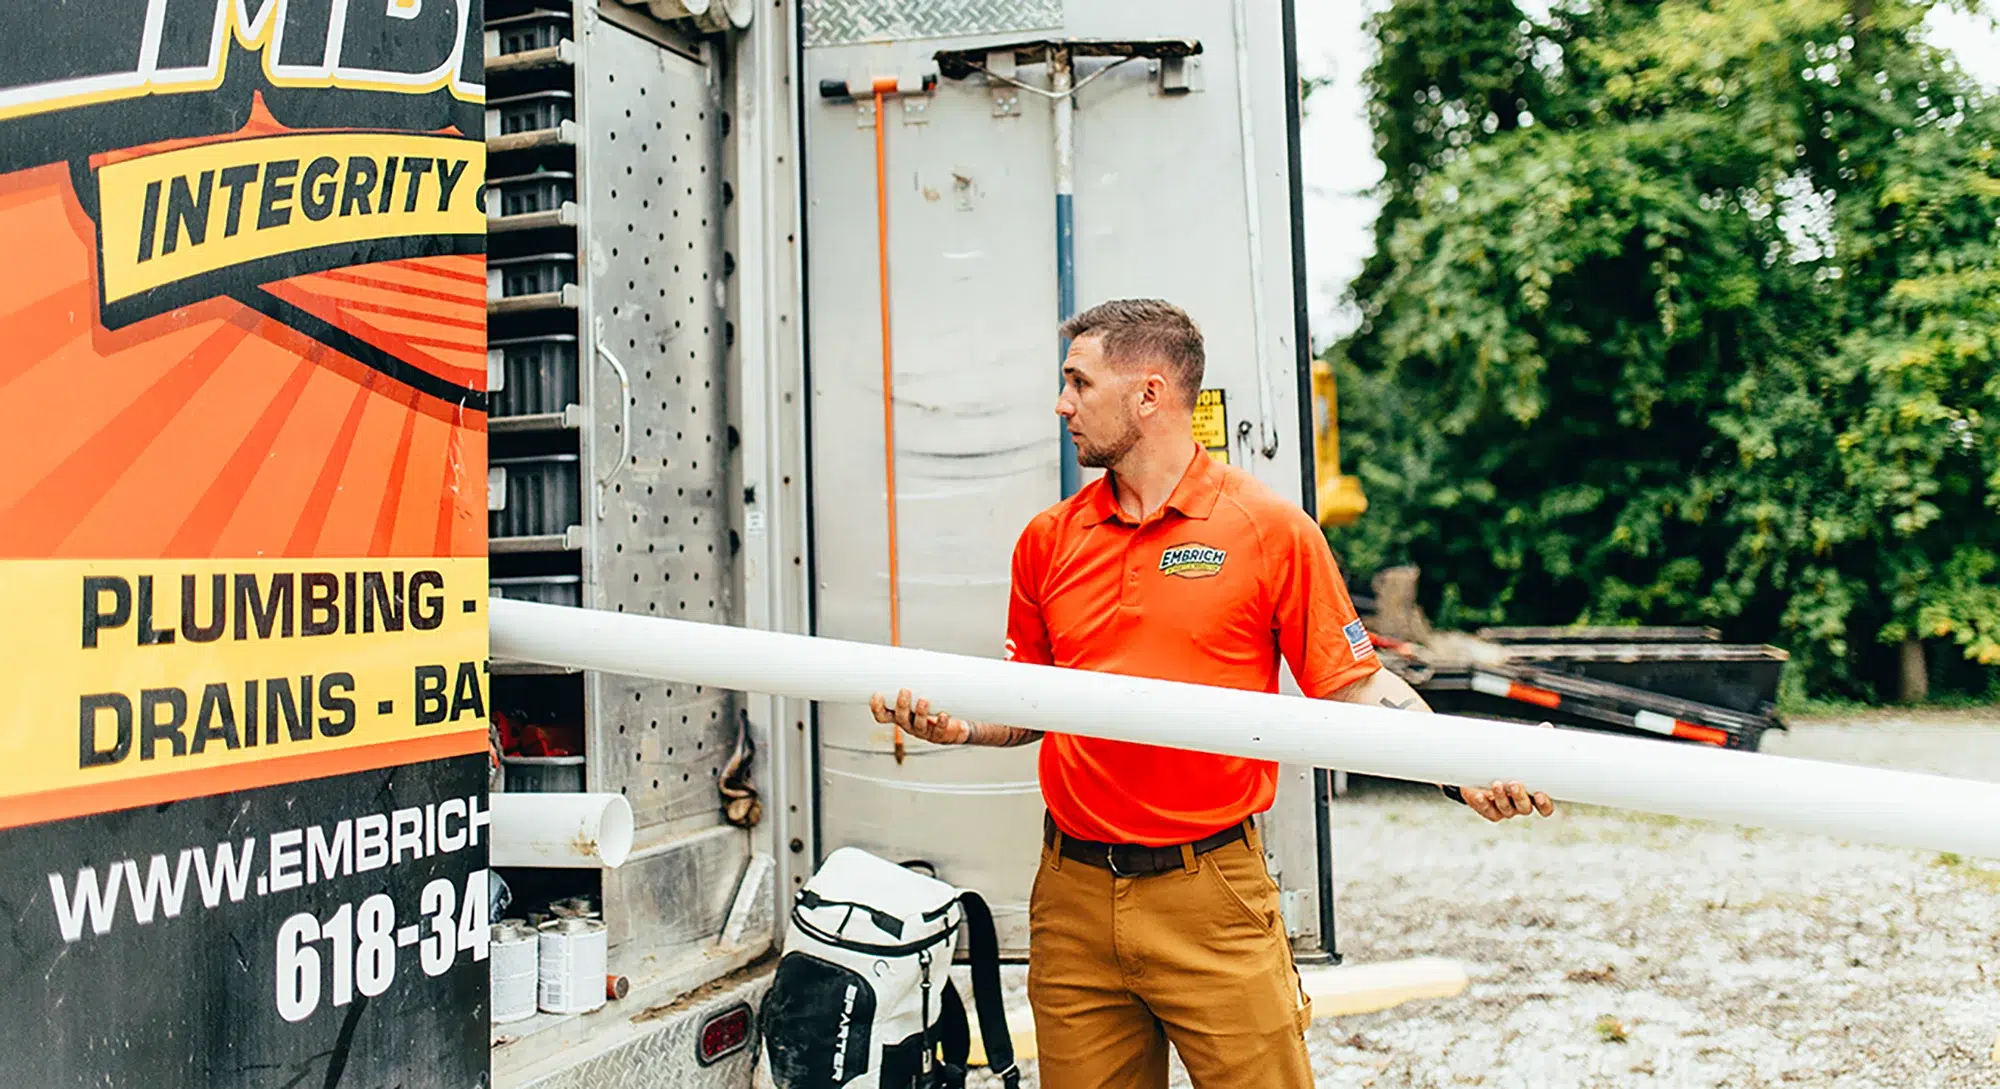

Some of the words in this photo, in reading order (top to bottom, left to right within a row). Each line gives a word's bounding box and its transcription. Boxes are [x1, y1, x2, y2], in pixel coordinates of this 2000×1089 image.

[137, 156, 468, 264] INTEGRITY
[82, 570, 445, 649] PLUMBING
[1161, 549, 1224, 566] EMBRICH
[79, 672, 357, 769] DRAINS
[414, 660, 488, 726] BA
[275, 868, 490, 1023] 618-34
